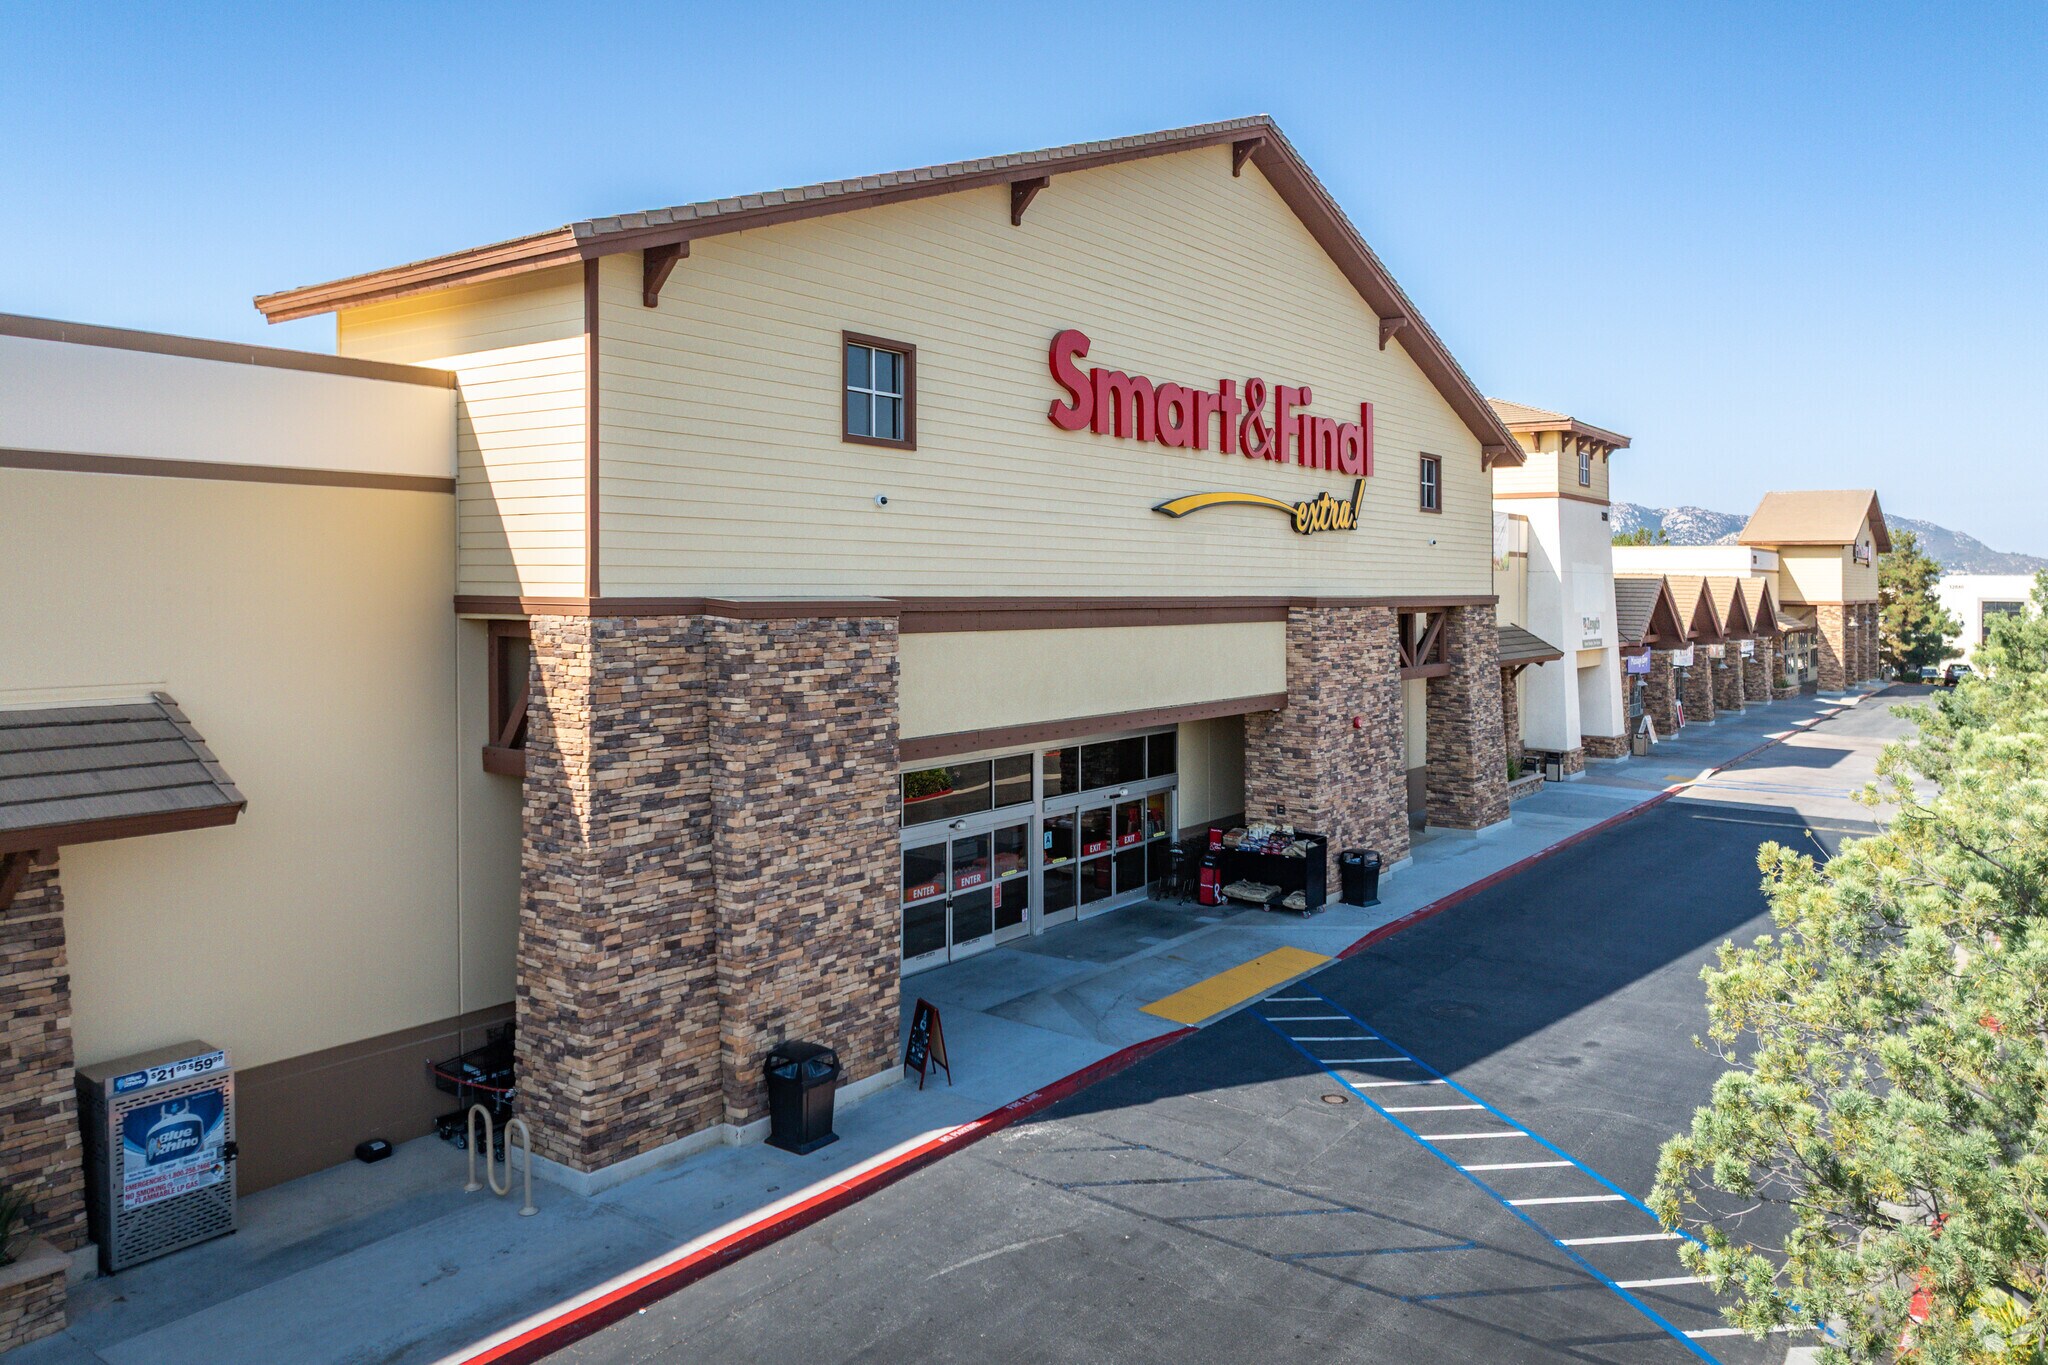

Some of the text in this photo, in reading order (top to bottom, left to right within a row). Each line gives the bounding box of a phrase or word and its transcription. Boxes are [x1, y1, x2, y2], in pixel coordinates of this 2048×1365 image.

[1048, 329, 1374, 477] Smart&Final
[1292, 479, 1366, 534] extra!
[1124, 833, 1136, 844] EXIT
[1089, 842, 1102, 853] EXIT
[961, 873, 982, 887] ENTER
[912, 885, 935, 899] ENTER
[1006, 1100, 1024, 1111] FIRE
[159, 1127, 193, 1143] Blue
[950, 1121, 982, 1139] PARKING
[125, 1183, 167, 1201] NO SMOKING
[134, 1180, 199, 1204] FLAMMABLE LP GAS
